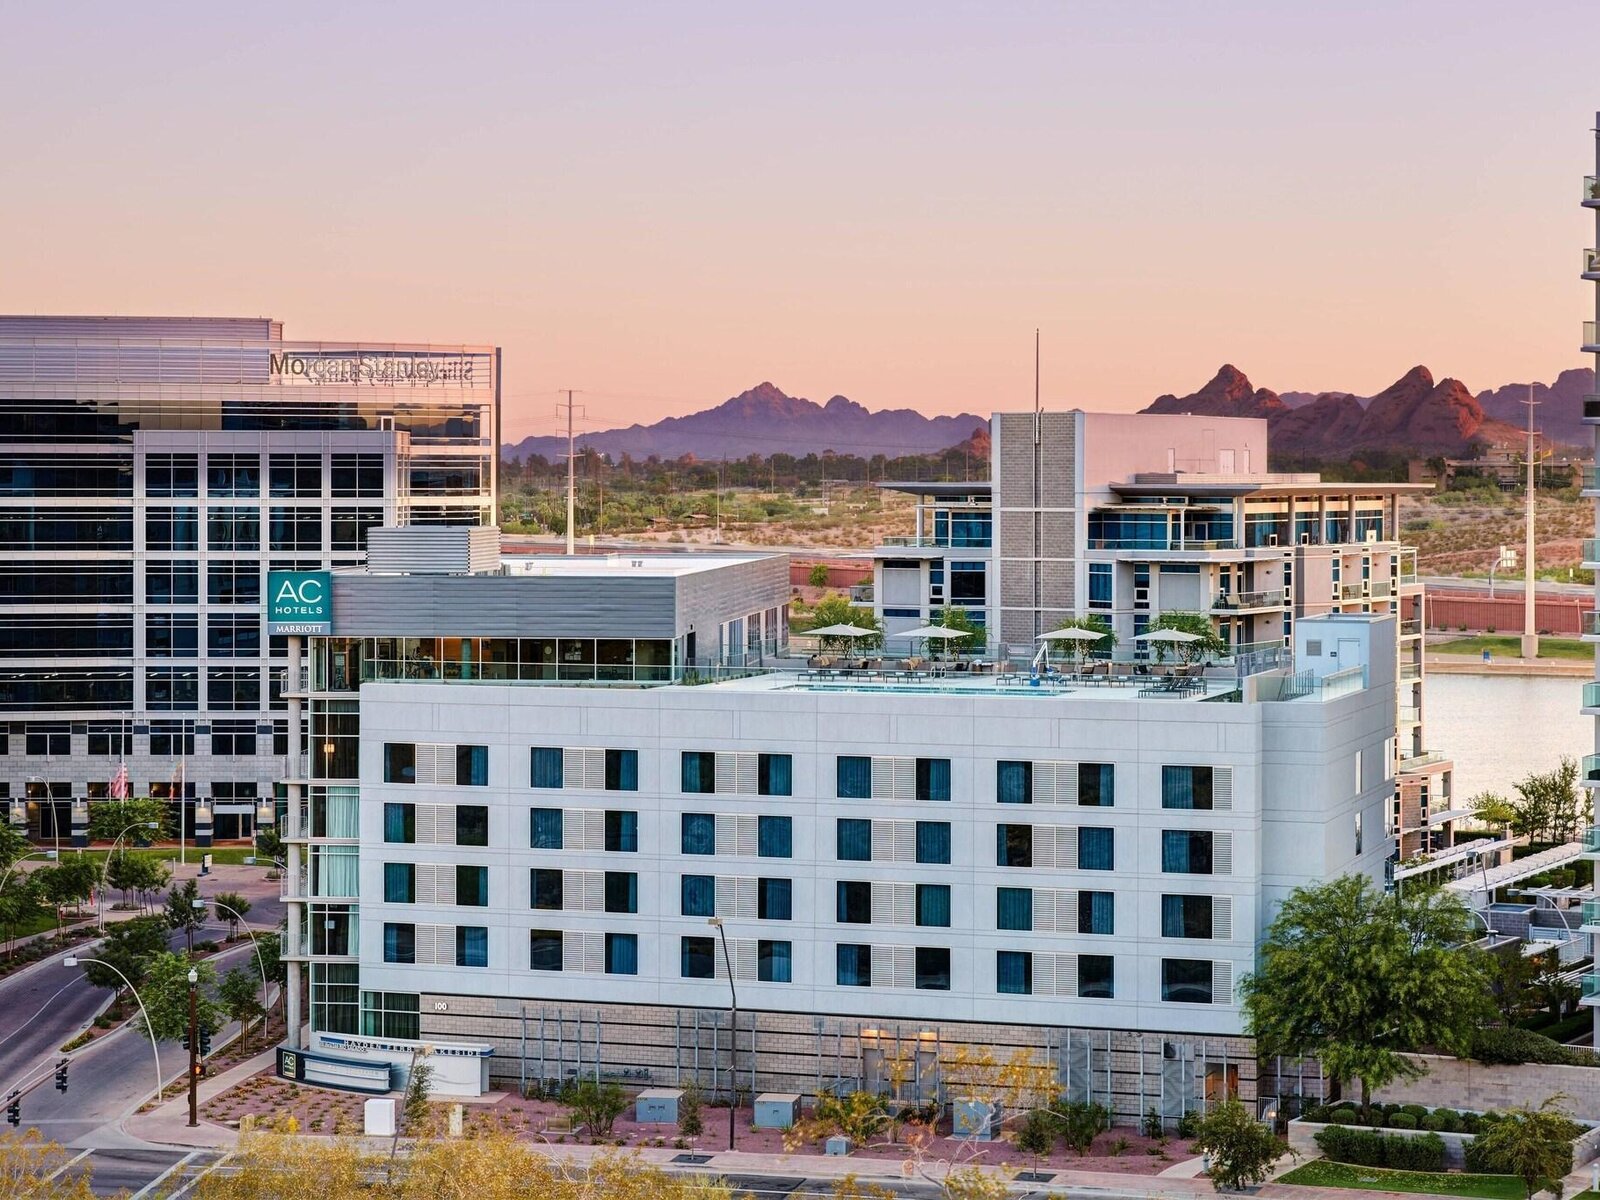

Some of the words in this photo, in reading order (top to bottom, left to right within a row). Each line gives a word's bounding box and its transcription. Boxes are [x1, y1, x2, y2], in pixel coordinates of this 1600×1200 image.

[269, 353, 354, 382] Morgan
[360, 355, 439, 384] Stanley
[275, 579, 322, 603] AC
[275, 606, 323, 614] HOTELS
[275, 625, 323, 633] MARRIOTT
[434, 1002, 448, 1010] 100
[387, 1043, 418, 1053] FERR
[431, 1047, 482, 1057] AKESIDE
